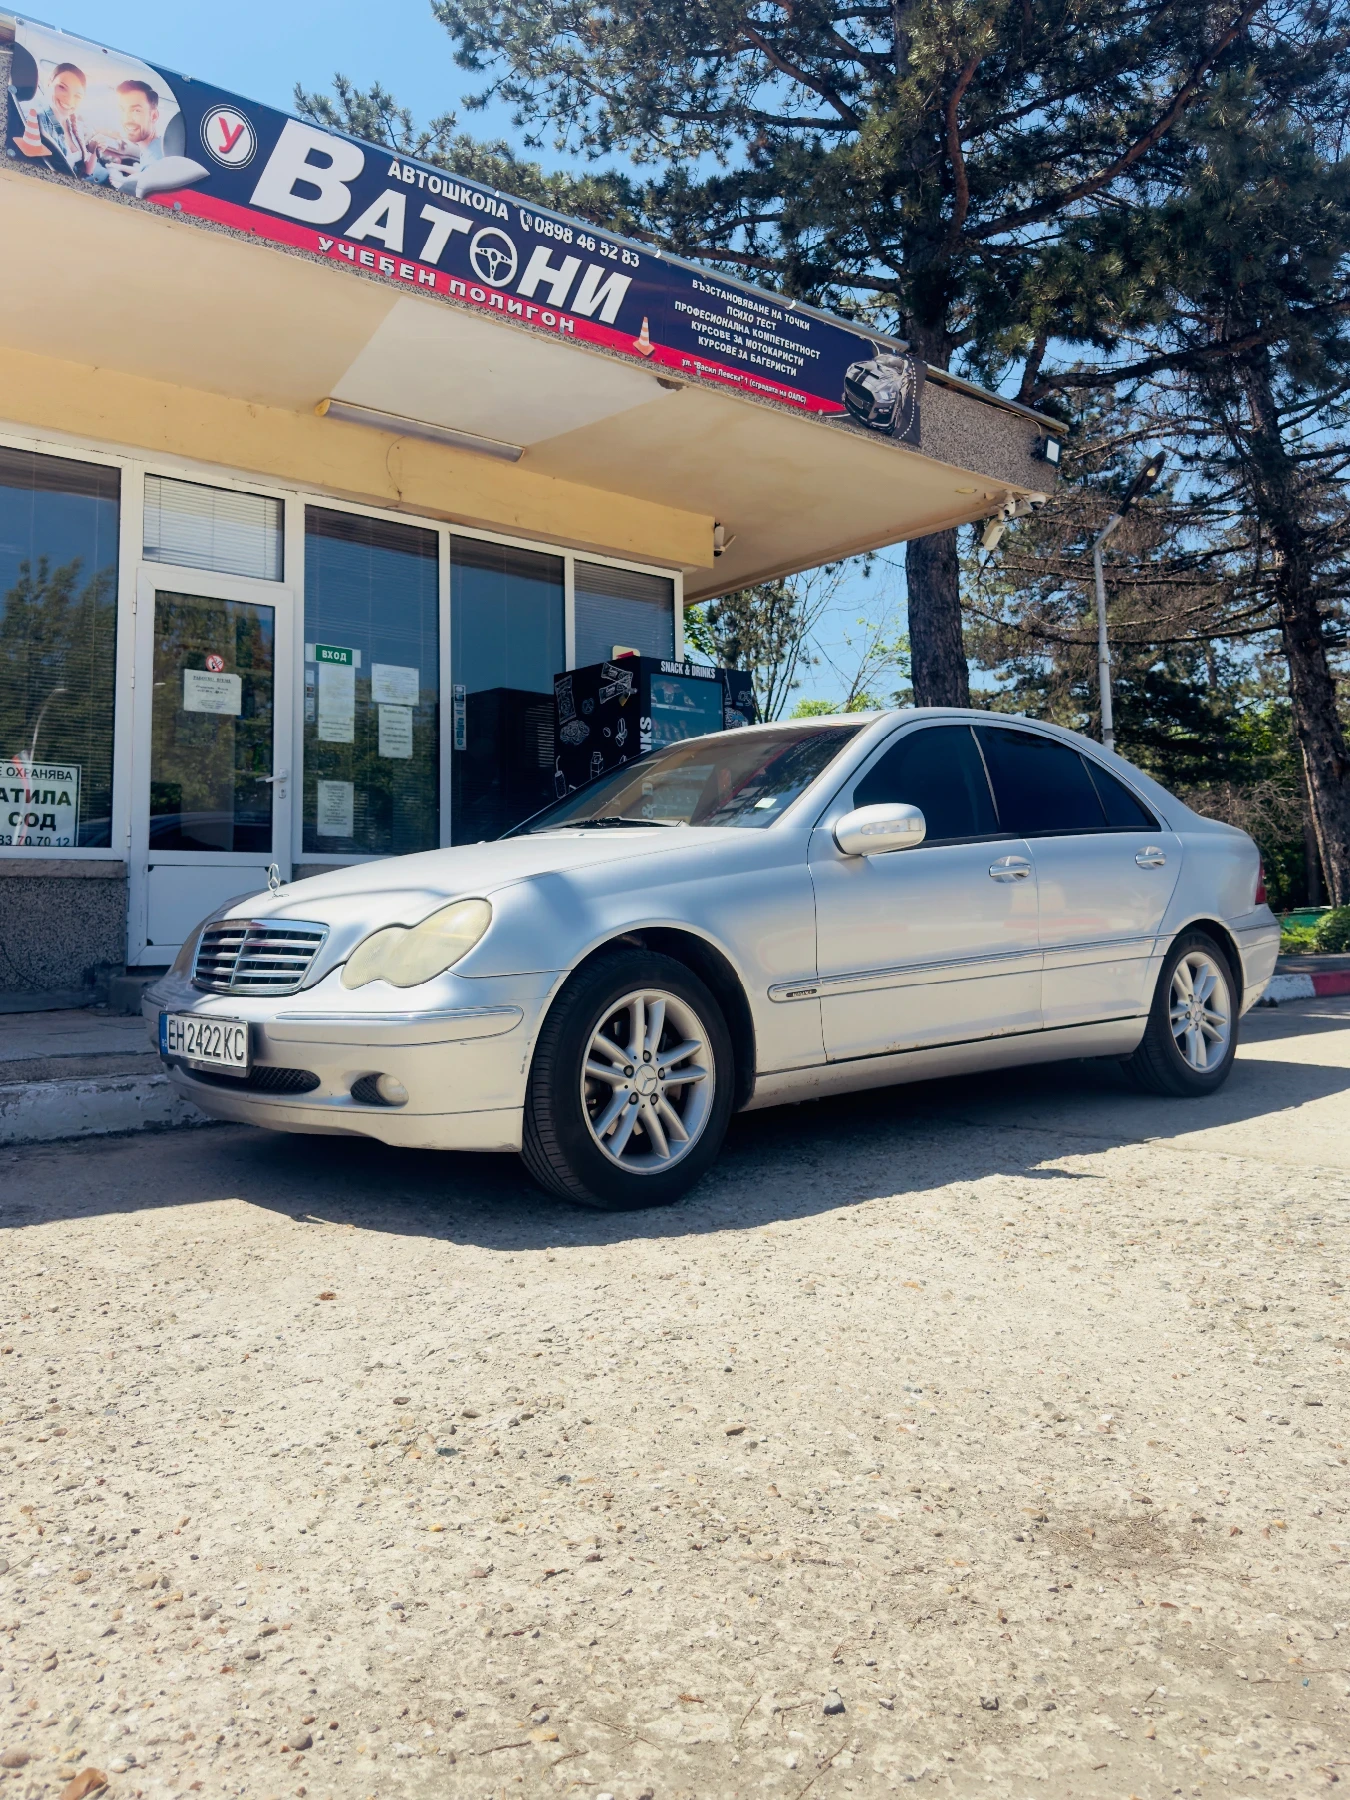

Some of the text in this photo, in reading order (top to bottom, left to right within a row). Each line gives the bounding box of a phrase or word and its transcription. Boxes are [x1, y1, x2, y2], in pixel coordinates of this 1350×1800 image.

[387, 160, 510, 221] АВТОШКОЛА
[534, 217, 641, 268] 0898 46 52 83
[317, 236, 575, 334] УЧЕБЕН ПОЛИГОН
[692, 279, 811, 331] ВЪЗСТАНОВЯВАНЕ НА ТОЧКИ
[726, 306, 777, 331] ПСИХО ТЕСТ
[674, 300, 821, 360] ПРОФЕСИОНАЛНА КОМПЕТЕНТНОСТ
[691, 320, 805, 367] КУРСОВЕ ЗА МОТОКАРИСТИ
[698, 336, 798, 377] КУРСОВЕ ЗА БАГЕРИСТИ
[681, 358, 692, 367] ул.
[779, 388, 787, 397] на
[321, 649, 348, 663] ВХОД
[660, 660, 716, 680] SNACK & DRINKS
[6, 766, 73, 780] ОХРАНЯВА
[0, 787, 72, 806] АТИЛА
[8, 812, 56, 831] СОД
[37, 836, 51, 846] 70
[56, 837, 70, 847] 12
